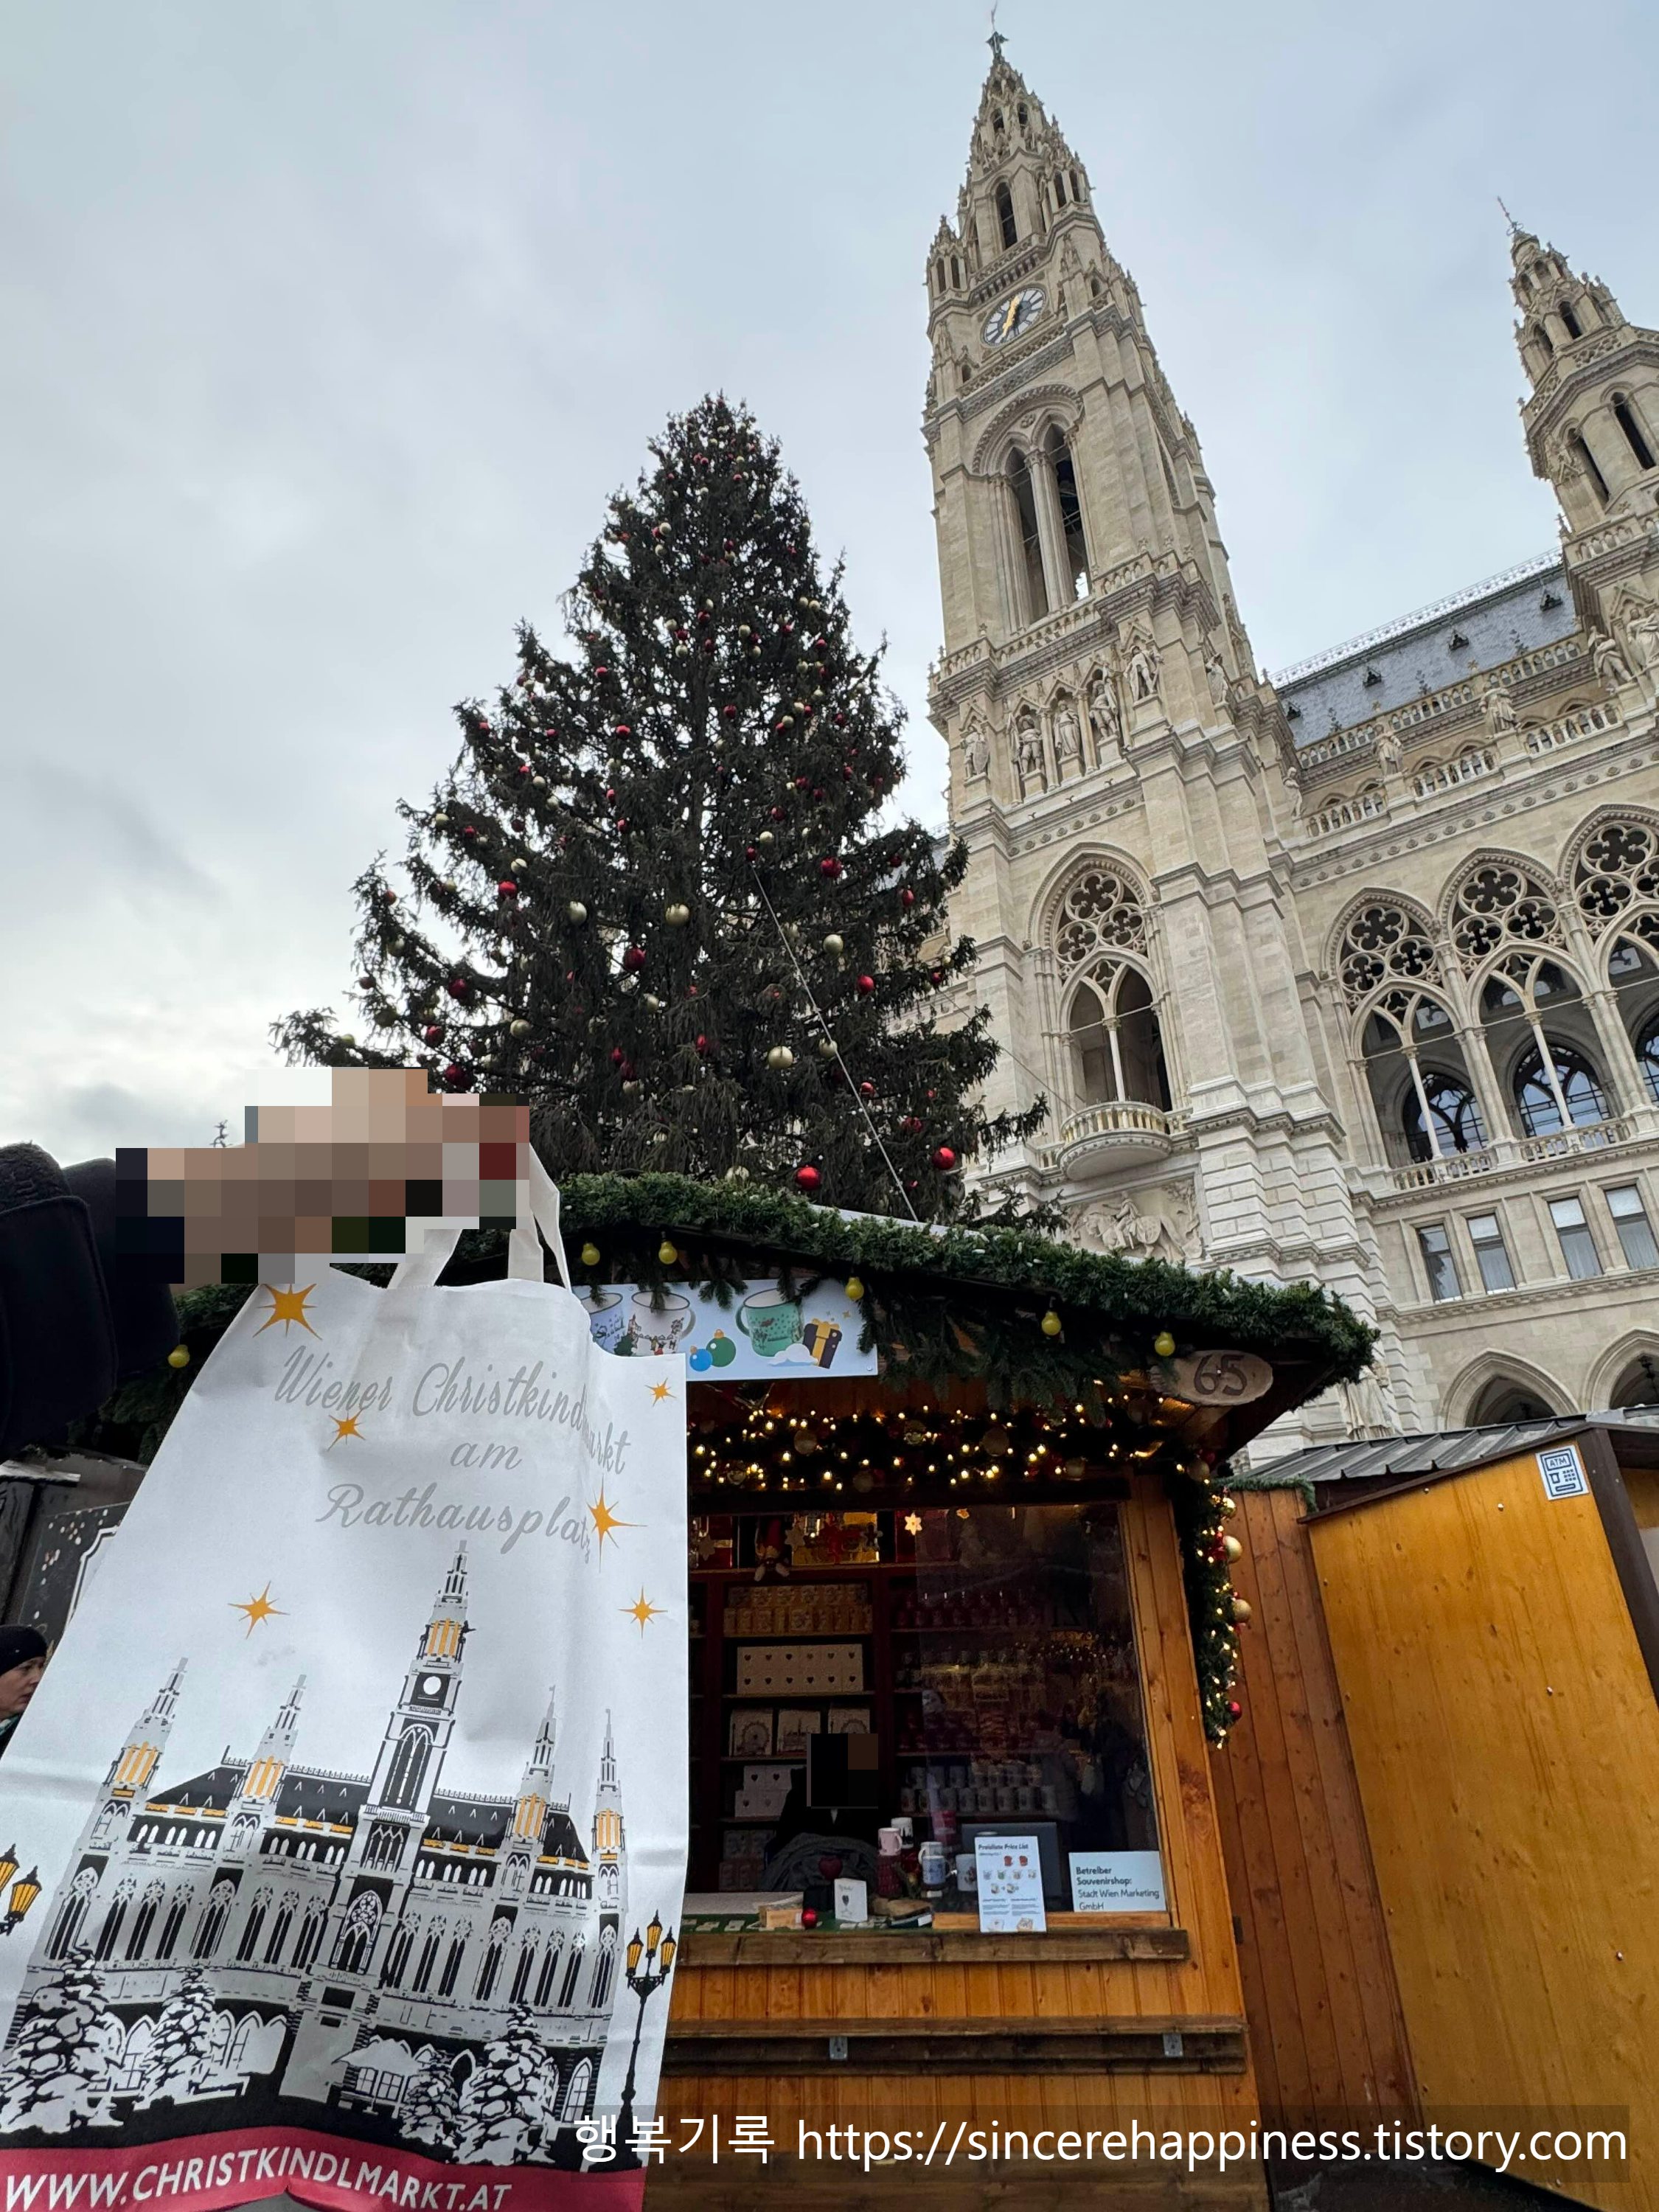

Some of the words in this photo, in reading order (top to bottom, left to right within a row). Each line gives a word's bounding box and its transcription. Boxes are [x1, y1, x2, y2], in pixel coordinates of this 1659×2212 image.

[274, 1345, 393, 1412] Wiener
[1194, 1354, 1248, 1397] 65
[450, 1440, 523, 1470] am
[1549, 1456, 1568, 1467] ATM
[315, 1483, 591, 1565] Rathausplatz
[1076, 1866, 1112, 1875] Betreiber
[1077, 1877, 1133, 1887] Souvenirshop:
[1099, 1889, 1119, 1898] Wien
[1120, 1888, 1160, 1900] Marketing
[1079, 1902, 1105, 1911] GmbH
[6, 2146, 512, 2212] WWW.CHRISTKINDLMARKT.AT
